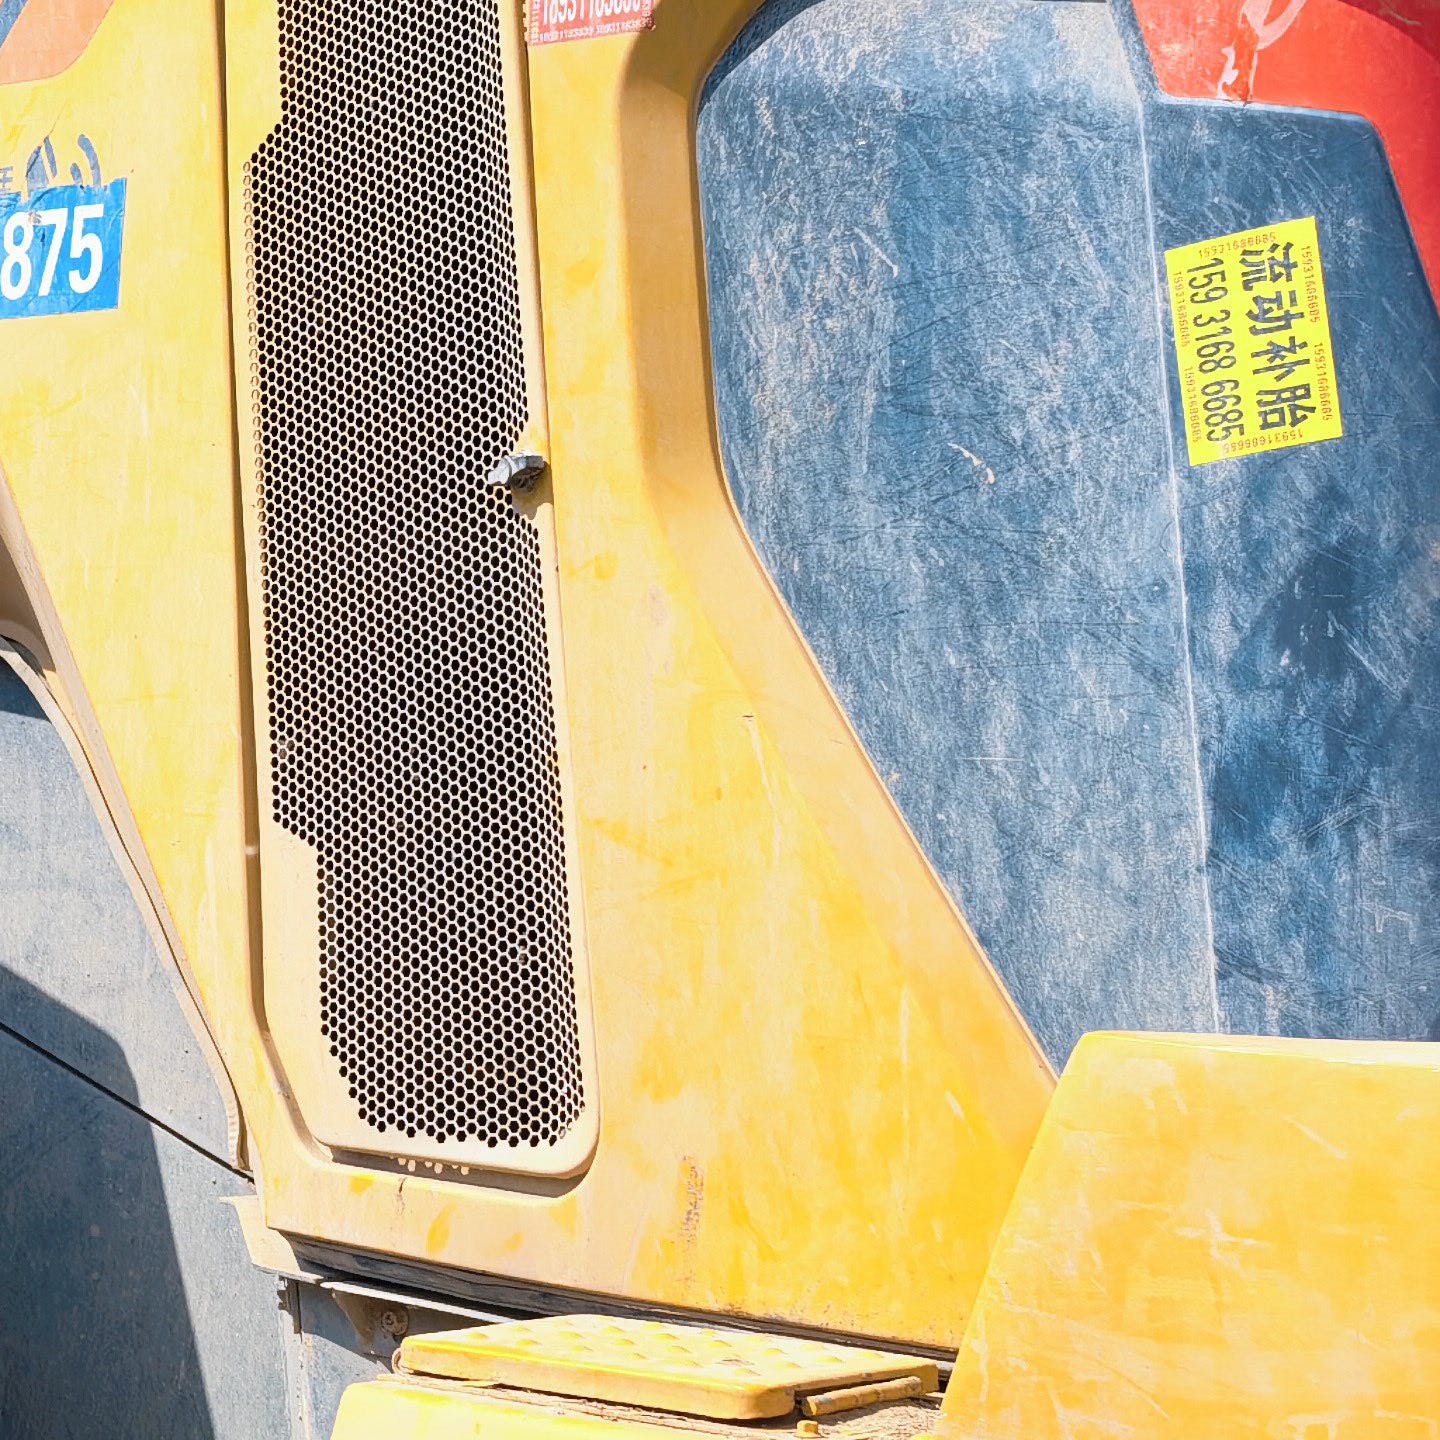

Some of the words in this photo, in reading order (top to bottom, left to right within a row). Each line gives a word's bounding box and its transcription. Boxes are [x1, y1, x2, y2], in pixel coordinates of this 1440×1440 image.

[1186, 257, 1229, 305] 159
[1192, 309, 1237, 375] 3168
[1238, 241, 1317, 431] 流动补胎
[1200, 378, 1245, 443] 6685
